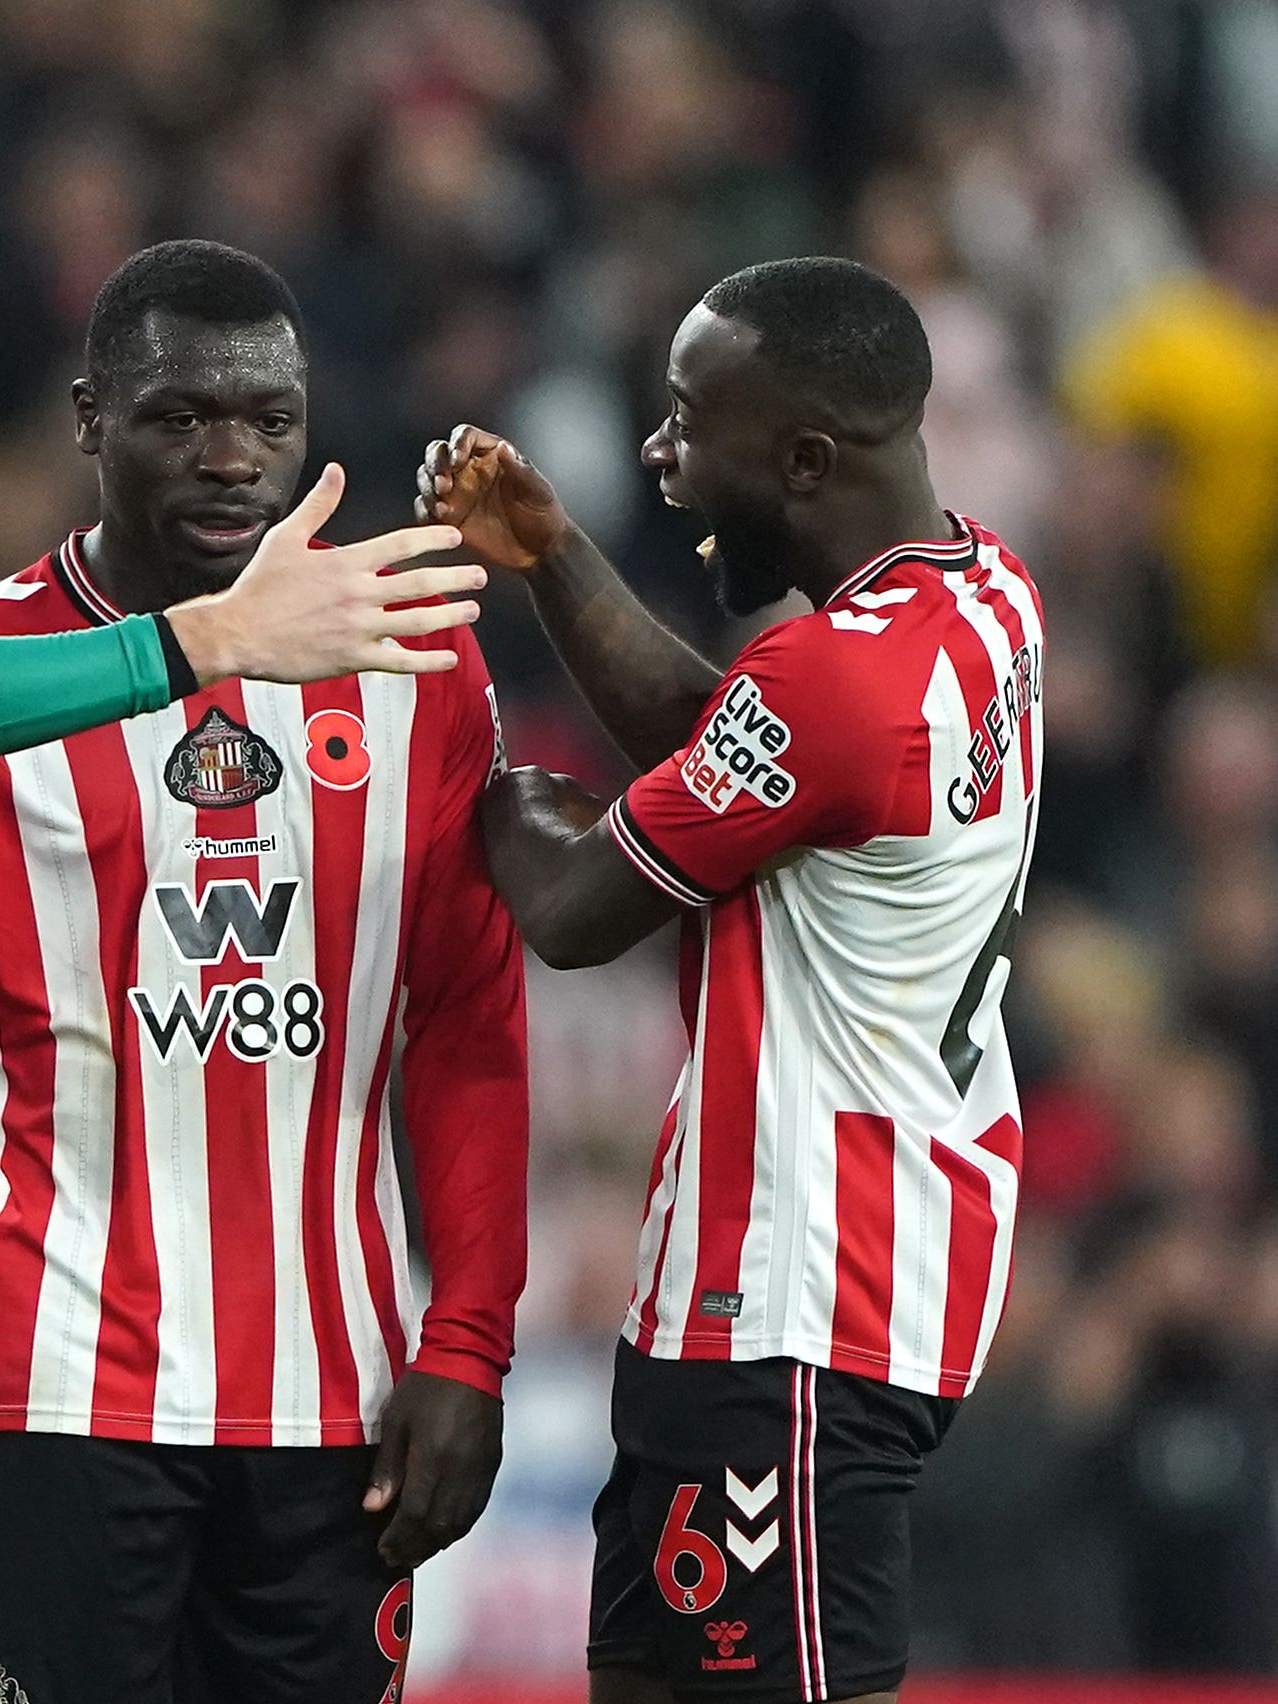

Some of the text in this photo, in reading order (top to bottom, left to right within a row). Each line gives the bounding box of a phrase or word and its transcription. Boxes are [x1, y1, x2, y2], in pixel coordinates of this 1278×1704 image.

[726, 679, 786, 754] Live
[685, 743, 732, 807] Bet
[705, 712, 790, 803] Score
[206, 835, 276, 855] hummel
[156, 881, 299, 959] W
[134, 982, 320, 1061] W88
[654, 1484, 727, 1614] 6
